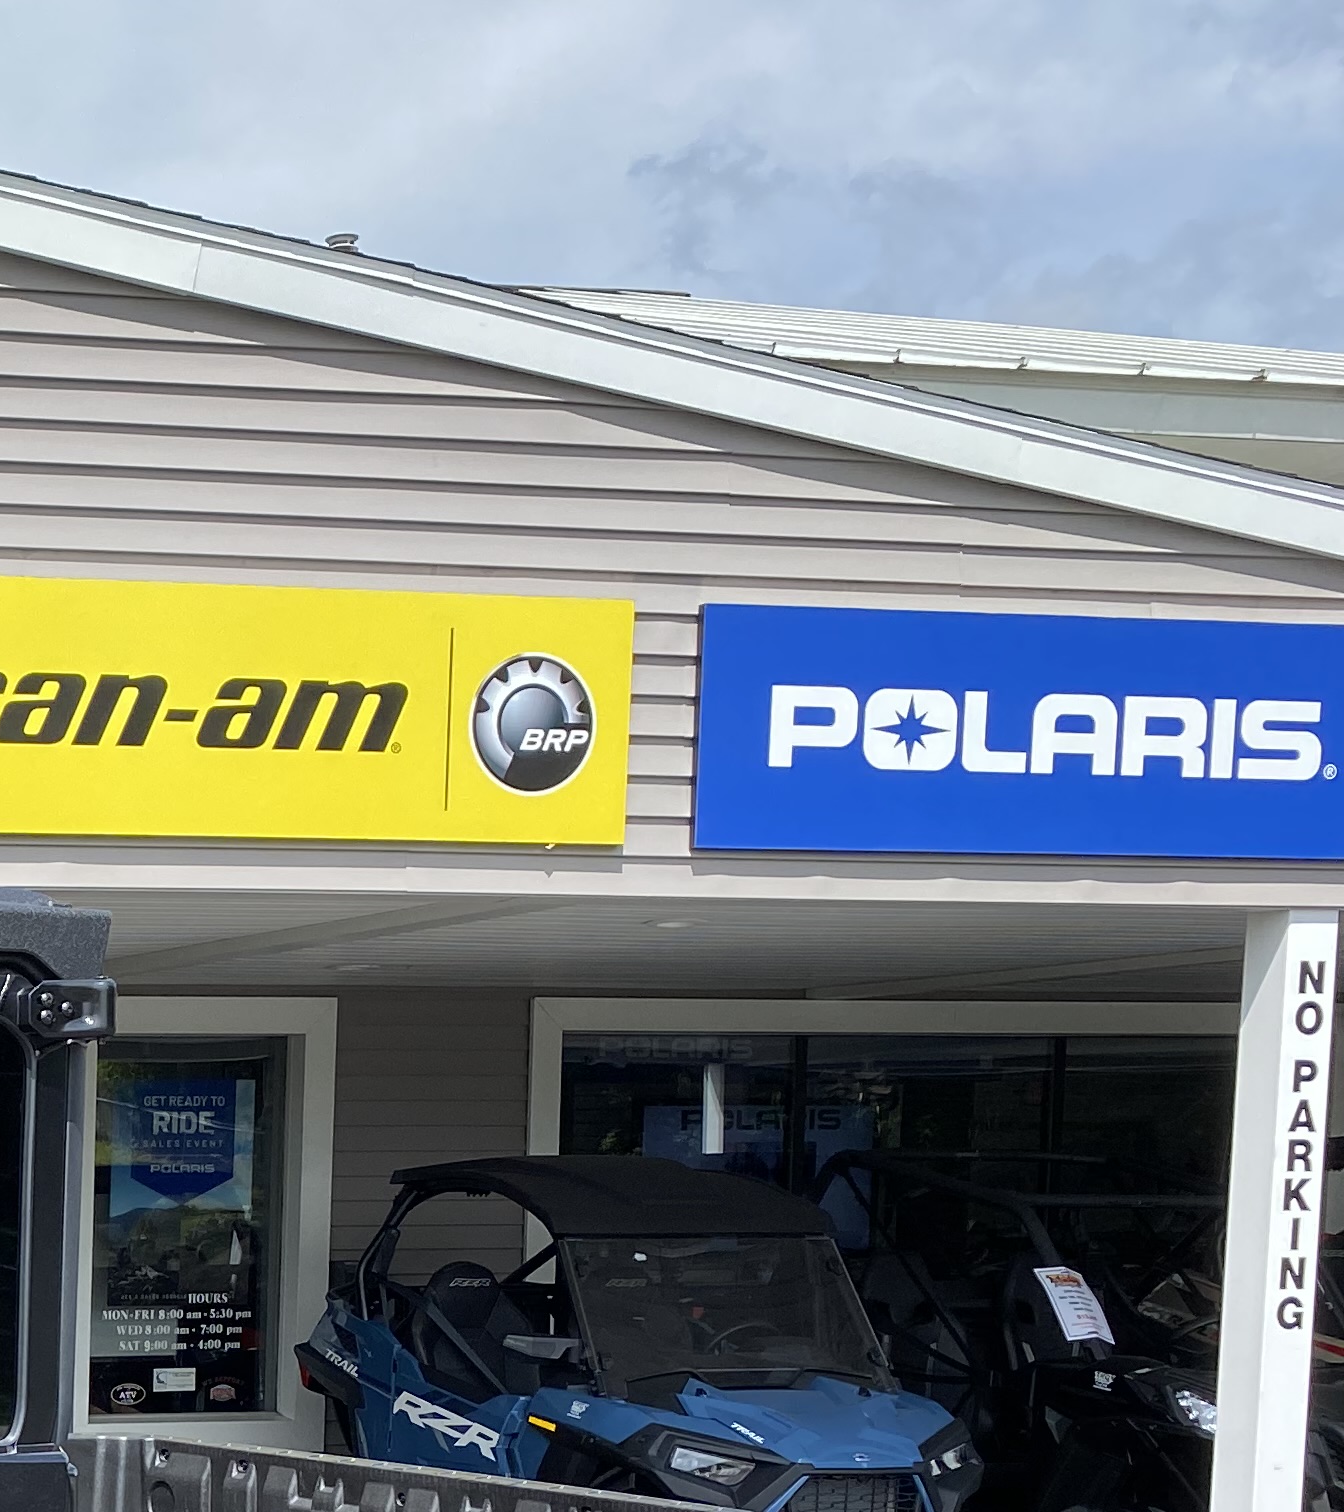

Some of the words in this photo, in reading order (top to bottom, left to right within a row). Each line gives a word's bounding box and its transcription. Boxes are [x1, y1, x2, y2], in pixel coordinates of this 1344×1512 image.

[767, 684, 1323, 781] POLARIS
[519, 728, 589, 752] BRP
[1295, 960, 1326, 1036] NO
[143, 1095, 168, 1108] GET
[169, 1095, 208, 1108] READY
[211, 1095, 226, 1108] TO
[152, 1110, 216, 1136] RIDE
[143, 1139, 181, 1149] SALES
[186, 1139, 224, 1149] EVENT
[150, 1163, 216, 1174] POLARIS
[1276, 1059, 1319, 1331] PARKING
[449, 1277, 492, 1288] RZR
[187, 1292, 229, 1304] HOURS
[158, 1309, 184, 1320] 8:00
[209, 1308, 234, 1319] 5:30
[235, 1311, 252, 1320] pm
[116, 1325, 143, 1335] WED
[144, 1324, 171, 1335] 8:00
[200, 1324, 224, 1334] 7:00
[226, 1326, 243, 1335] pm
[119, 1340, 141, 1351] SAT
[144, 1340, 168, 1351] 9:00
[198, 1339, 222, 1350] 4:00
[224, 1341, 241, 1351] pm
[325, 1349, 360, 1378] TRAIL
[119, 1390, 138, 1399] ATV
[393, 1390, 501, 1462] RZR
[730, 1420, 766, 1444] TRAIL
